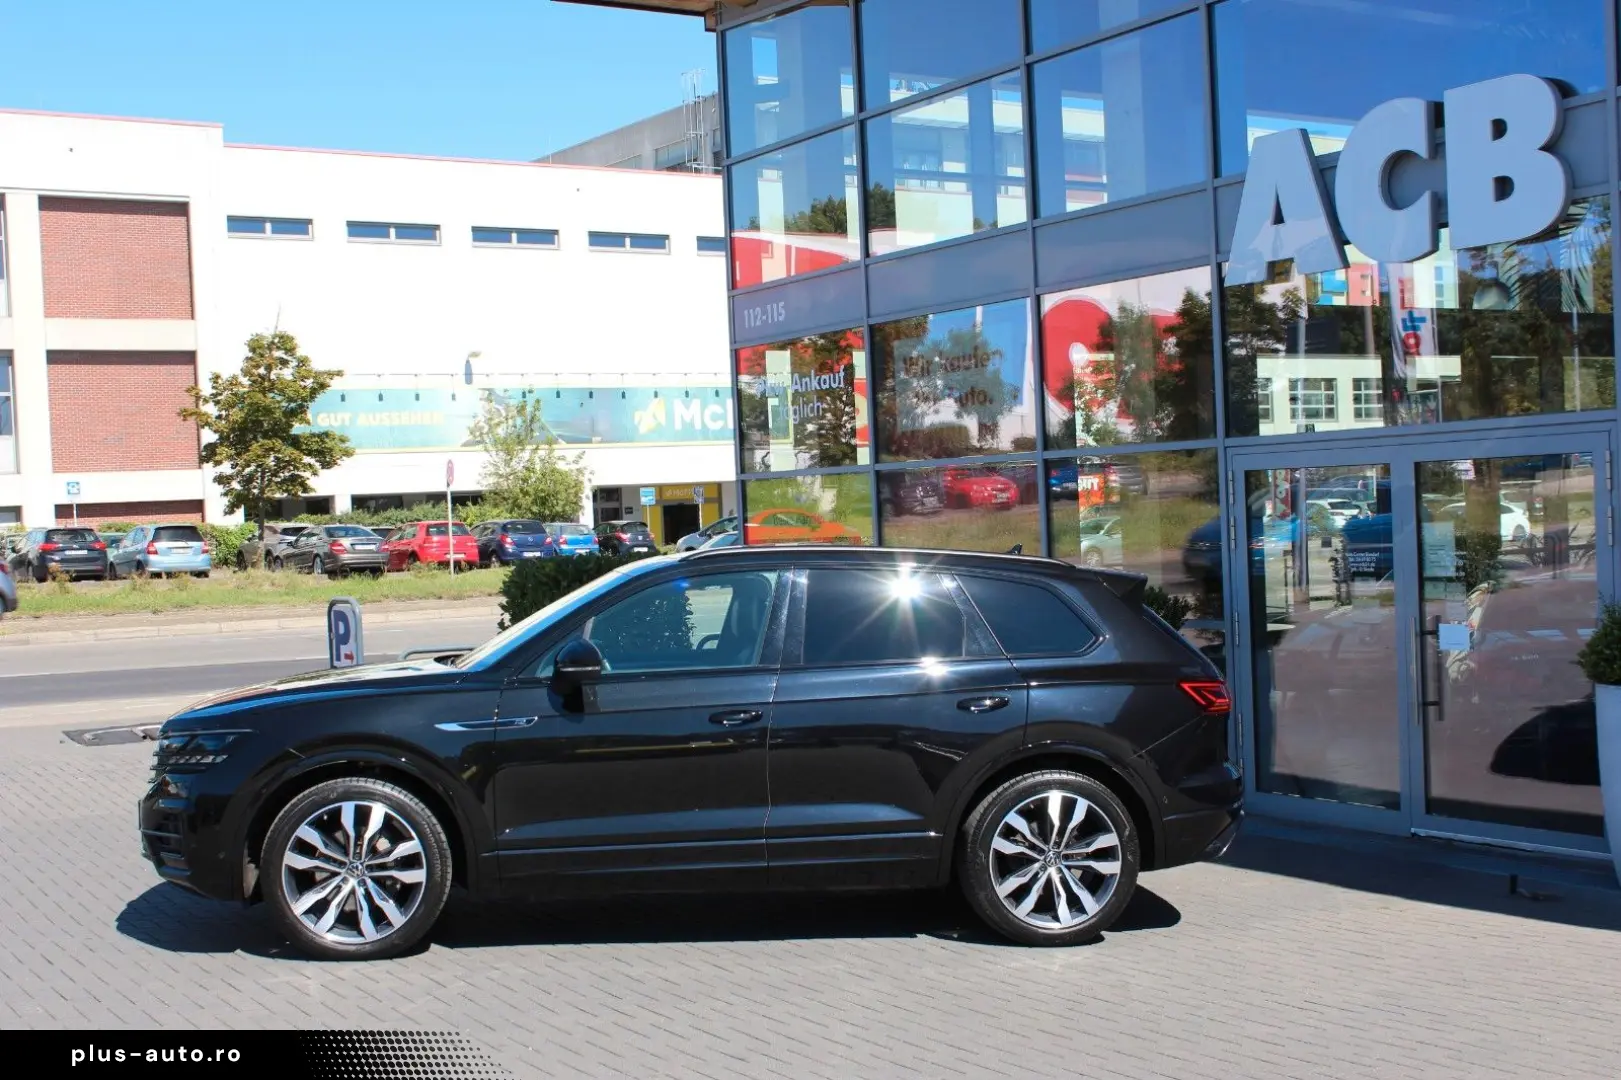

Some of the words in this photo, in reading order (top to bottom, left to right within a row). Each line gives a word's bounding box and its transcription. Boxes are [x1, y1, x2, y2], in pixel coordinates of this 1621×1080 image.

[1224, 73, 1572, 287] ACB
[744, 302, 786, 329] 112-115
[791, 365, 845, 393] Ankauf
[317, 412, 352, 427] GUT
[333, 609, 351, 662] P
